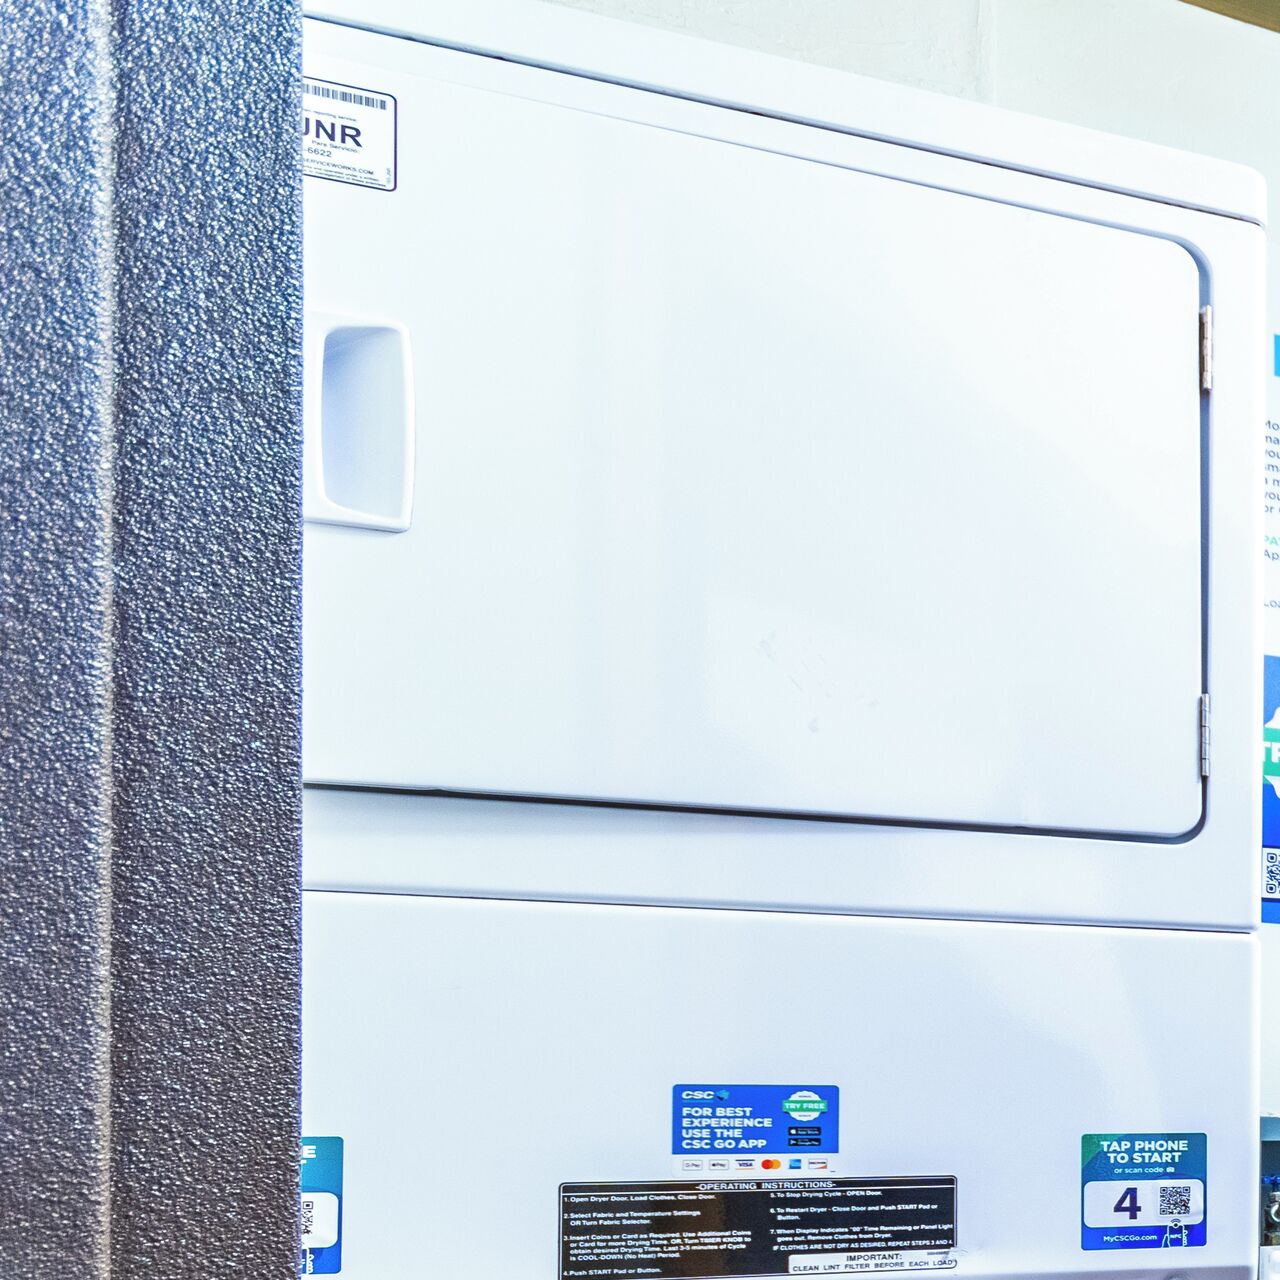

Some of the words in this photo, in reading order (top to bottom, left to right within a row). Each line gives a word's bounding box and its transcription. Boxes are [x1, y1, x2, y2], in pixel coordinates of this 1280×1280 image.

[681, 1090, 714, 1100] CSC
[784, 1102, 801, 1110] TRY
[803, 1102, 826, 1110] FREE
[682, 1107, 712, 1117] FOR
[716, 1107, 753, 1117] BEST
[682, 1118, 773, 1128] EXPERIENCE
[682, 1128, 711, 1138] USE
[713, 1128, 743, 1138] THE
[681, 1140, 711, 1149] CSC
[714, 1139, 736, 1149] GO
[738, 1139, 767, 1149] APP
[1100, 1141, 1131, 1151] TAP
[1135, 1140, 1188, 1151] PHONE
[1107, 1153, 1129, 1164] TO
[1133, 1152, 1182, 1163] START
[1144, 1166, 1164, 1174] code
[1113, 1187, 1142, 1220] 4
[1103, 1234, 1158, 1243] MyCSCGo.com
[846, 1253, 903, 1262] IMPORTANT:
